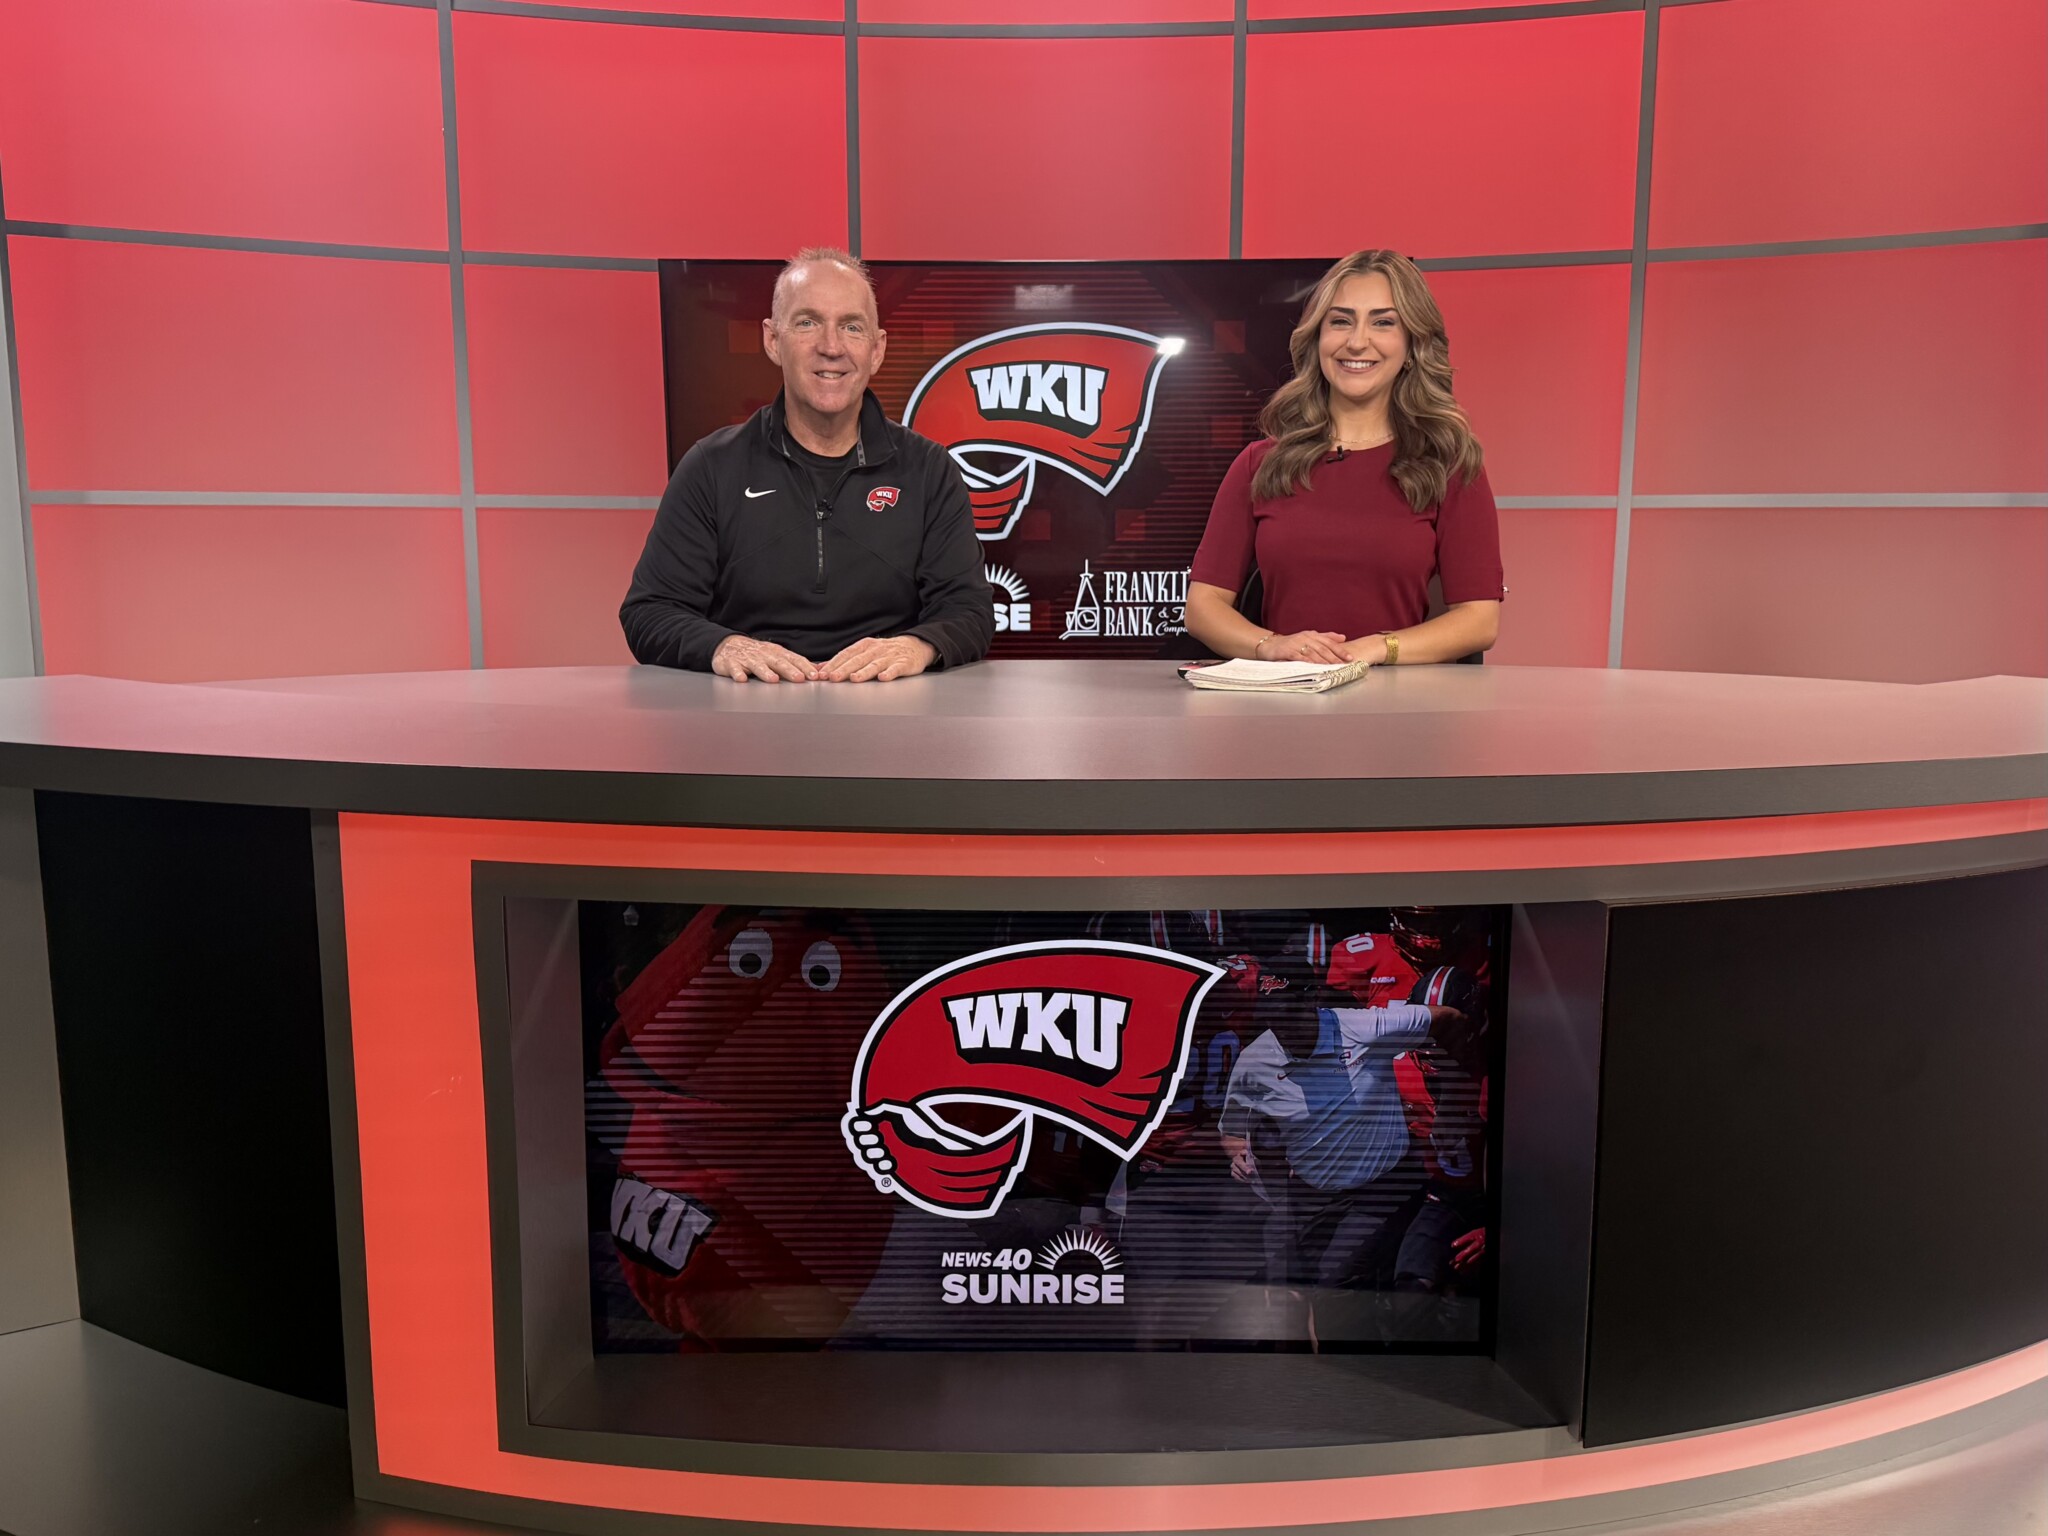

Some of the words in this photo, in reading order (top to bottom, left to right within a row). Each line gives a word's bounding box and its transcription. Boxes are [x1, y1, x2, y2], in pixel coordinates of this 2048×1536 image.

[970, 364, 1106, 426] WKU
[876, 490, 893, 499] WKU
[1103, 606, 1155, 637] BANK
[1158, 606, 1169, 618] &
[948, 992, 1126, 1070] WKU
[941, 1252, 992, 1268] NEWS
[992, 1248, 1033, 1271] 40
[941, 1273, 1125, 1304] SUNRISE
